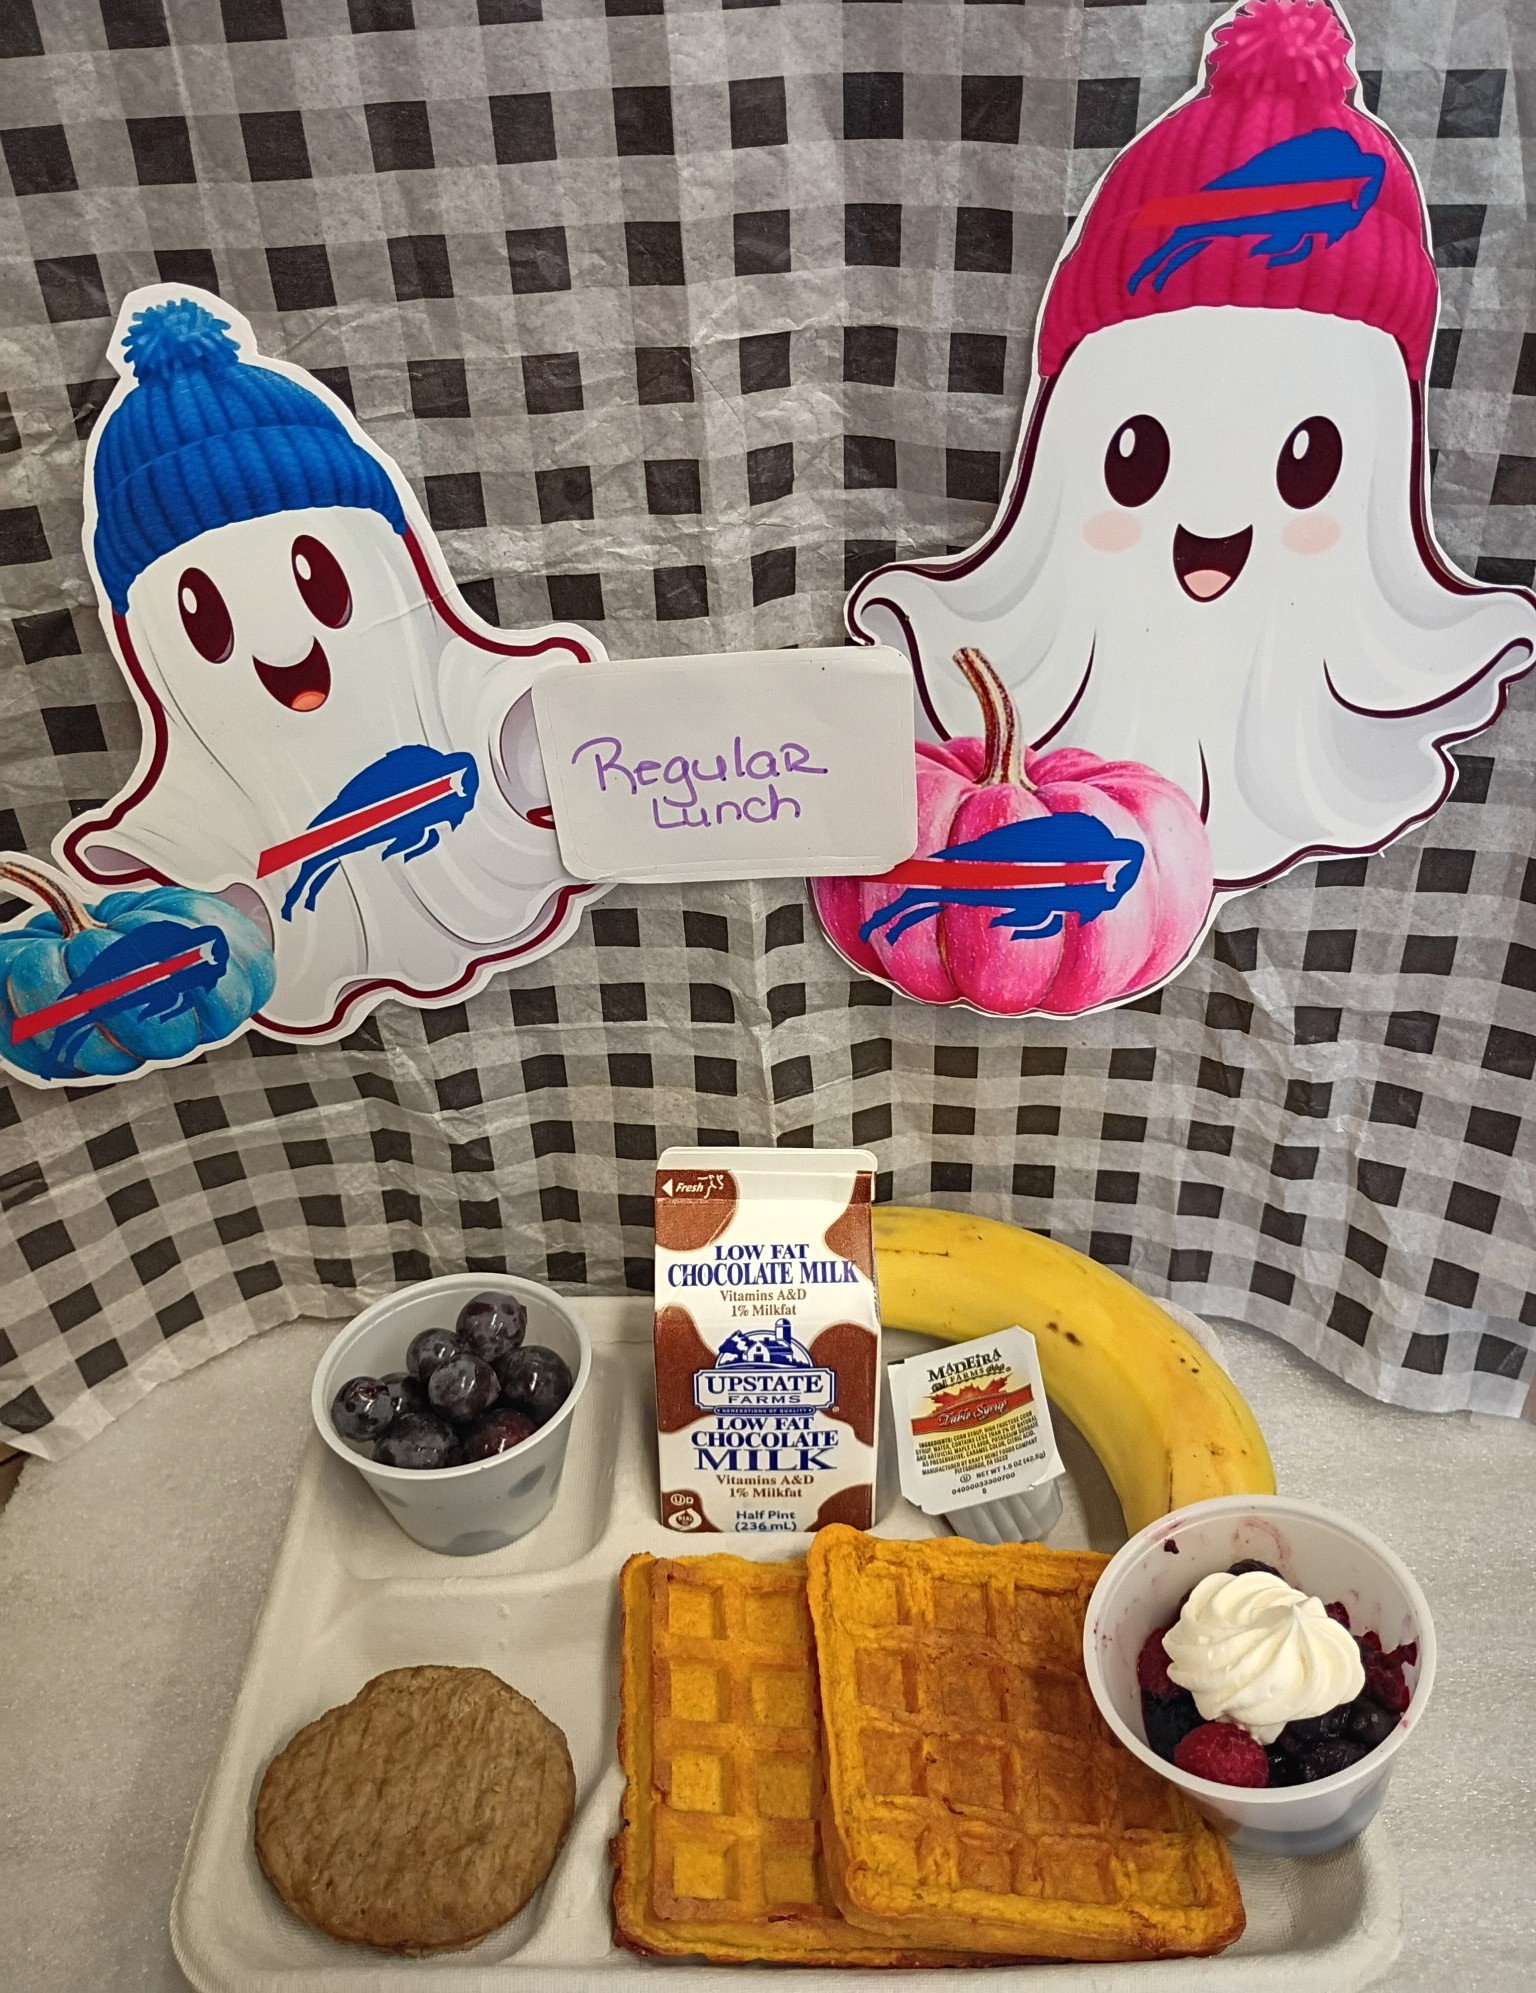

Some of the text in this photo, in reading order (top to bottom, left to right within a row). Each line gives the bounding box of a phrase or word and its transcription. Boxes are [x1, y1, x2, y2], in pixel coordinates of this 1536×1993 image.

[676, 1183, 703, 1192] Fresh
[715, 1244, 809, 1260] LOW FAT
[668, 1261, 859, 1287] CHOCOLATE MILK
[720, 1289, 806, 1302] Vitamins A&D
[731, 1304, 796, 1316] 1% Milkfat
[950, 1368, 984, 1383] FARMS
[705, 1375, 823, 1394] UPSTATE
[973, 1399, 1008, 1420] Syrup
[717, 1417, 814, 1430] LOW FAT
[954, 1433, 966, 1441] CORN
[1020, 1410, 1032, 1420] CORN
[976, 1433, 988, 1441] LESS
[989, 1430, 1001, 1438] THAN
[1017, 1415, 1038, 1428] NATURAL
[691, 1432, 838, 1447] CHOCOLATE
[928, 1450, 953, 1459] ARTIFICIAL
[955, 1445, 969, 1453] MAPLE
[991, 1430, 1017, 1443] POTASSIUM
[694, 1448, 837, 1471] MILK
[922, 1462, 960, 1475] MANUFACTURED
[968, 1455, 983, 1464] KRAFT
[985, 1451, 998, 1460] HEINZ
[1015, 1436, 1037, 1450] COMPANY
[966, 1447, 988, 1457] CARAMEL
[976, 1470, 989, 1478] NET
[990, 1466, 1000, 1474] WT
[1013, 1459, 1022, 1467] OZ
[717, 1474, 814, 1485] Vitamins A&D
[729, 1487, 802, 1497] 1% Milkfat
[737, 1510, 795, 1519] Half Pint
[735, 1522, 797, 1532] (236 mL)
